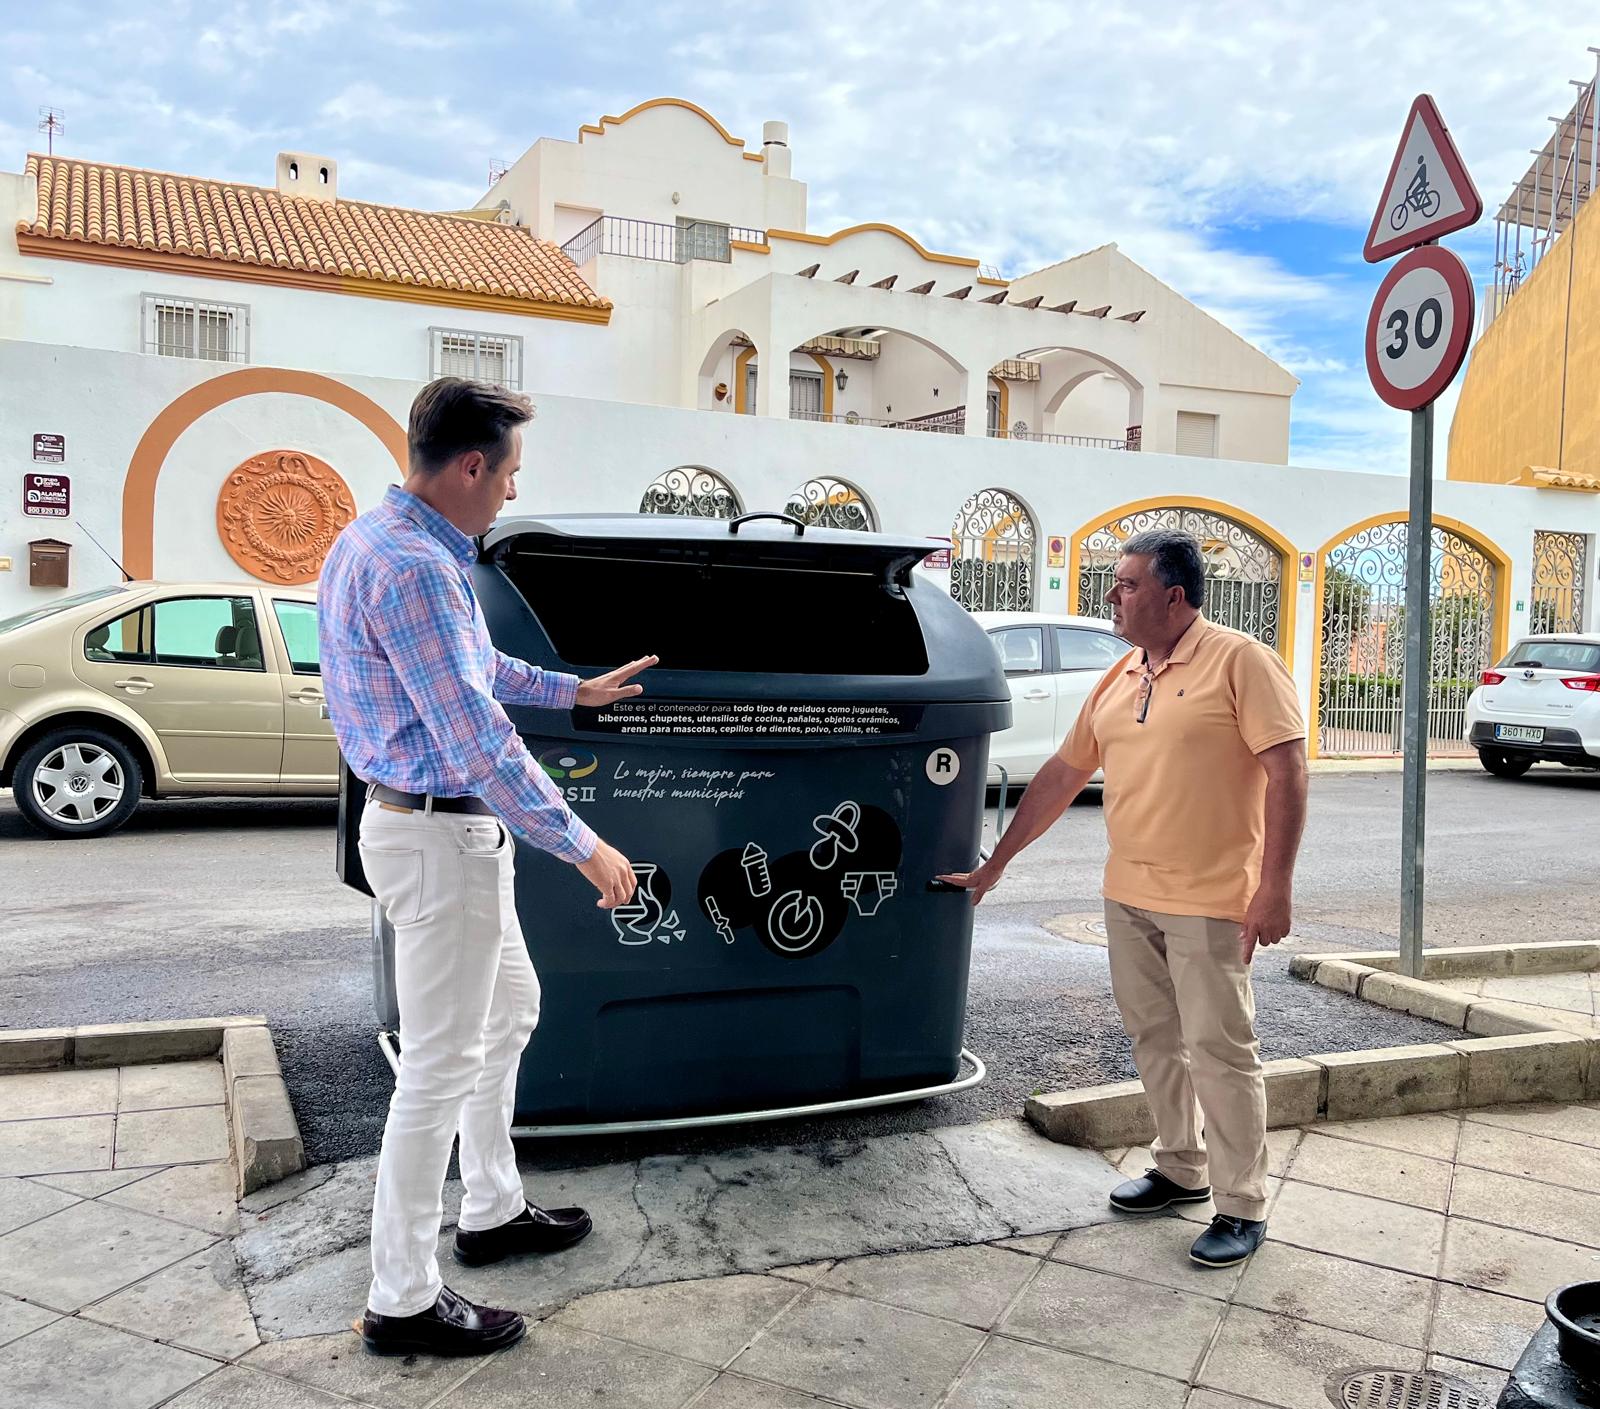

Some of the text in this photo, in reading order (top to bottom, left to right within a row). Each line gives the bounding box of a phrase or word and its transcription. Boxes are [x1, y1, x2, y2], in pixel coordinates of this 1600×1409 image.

[1386, 298, 1442, 359] 30
[613, 703, 633, 712] Este
[635, 704, 646, 712] es
[648, 703, 657, 712] el
[658, 704, 709, 712] contenedor
[711, 705, 732, 713] para
[733, 704, 755, 713] todo
[756, 704, 775, 714] tipo
[776, 704, 788, 713] de
[789, 705, 826, 713] residuos
[851, 705, 889, 715] juguetes,
[598, 714, 900, 725] biberones, chupetes, utensilios de cocina, pañales, objetos cerámicos,
[649, 726, 671, 734] para
[673, 725, 718, 734] mascotas,
[720, 724, 754, 734] cepillos
[755, 724, 767, 733] de
[769, 724, 803, 734] dientes,
[805, 725, 831, 734] polvo,
[833, 725, 864, 734] colillas,
[865, 726, 881, 734] etc.
[1502, 726, 1541, 739] 3601 HXD
[936, 753, 951, 772] R
[613, 761, 776, 787] Lo mejor, siempre para
[613, 785, 746, 807] nuestros municipios
